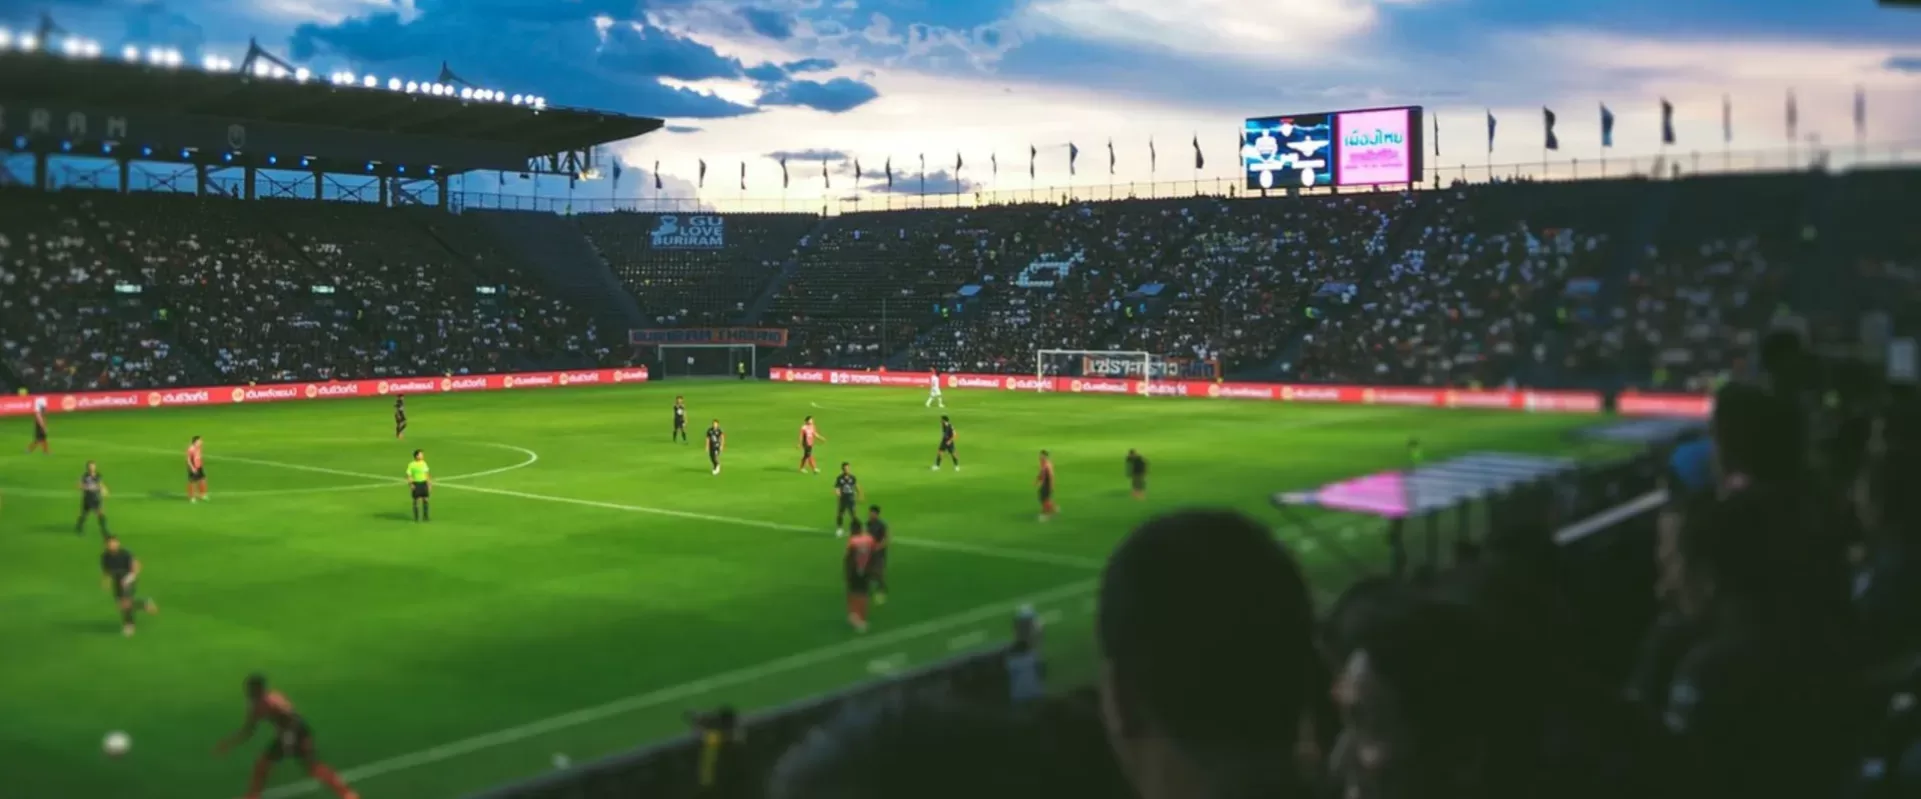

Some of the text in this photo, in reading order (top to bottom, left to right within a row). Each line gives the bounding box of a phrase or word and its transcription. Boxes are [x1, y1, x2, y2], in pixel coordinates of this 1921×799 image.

[1344, 128, 1404, 146] เมืองไทย
[689, 215, 724, 226] GU
[680, 226, 724, 236] LOVE
[653, 236, 723, 245] BURIRAM
